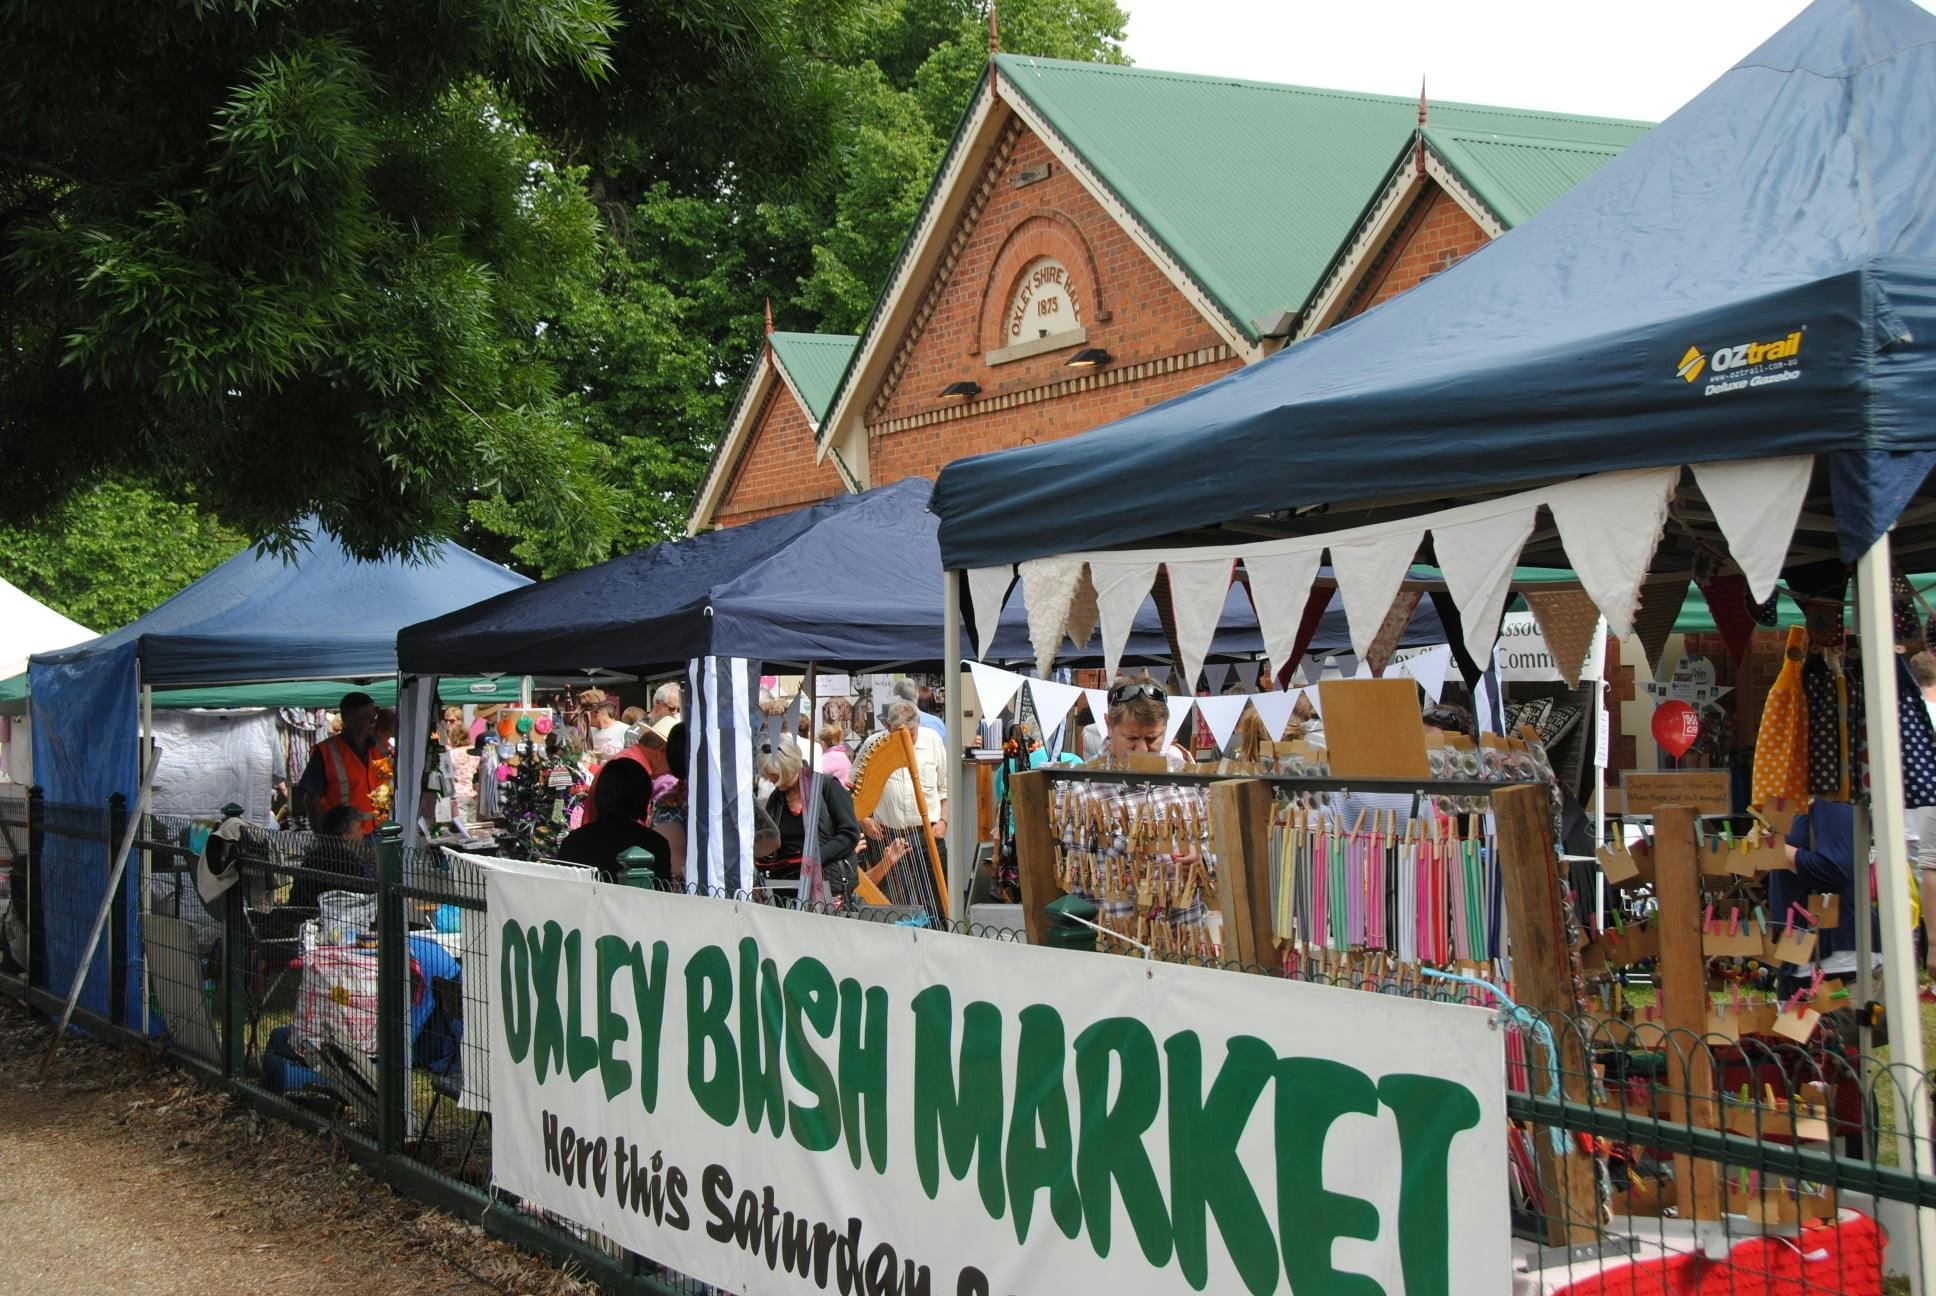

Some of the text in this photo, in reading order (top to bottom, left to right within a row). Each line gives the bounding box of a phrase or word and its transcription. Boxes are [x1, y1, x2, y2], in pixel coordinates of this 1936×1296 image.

[1012, 267, 1080, 335] OXLEY SHIRE HALL
[1038, 297, 1058, 317] 1875
[1705, 370, 1801, 396] Deluxe Gazebo
[502, 918, 1480, 1296] OXLEY BUSH MARKET
[542, 1109, 608, 1198] Here
[614, 1136, 690, 1231] this
